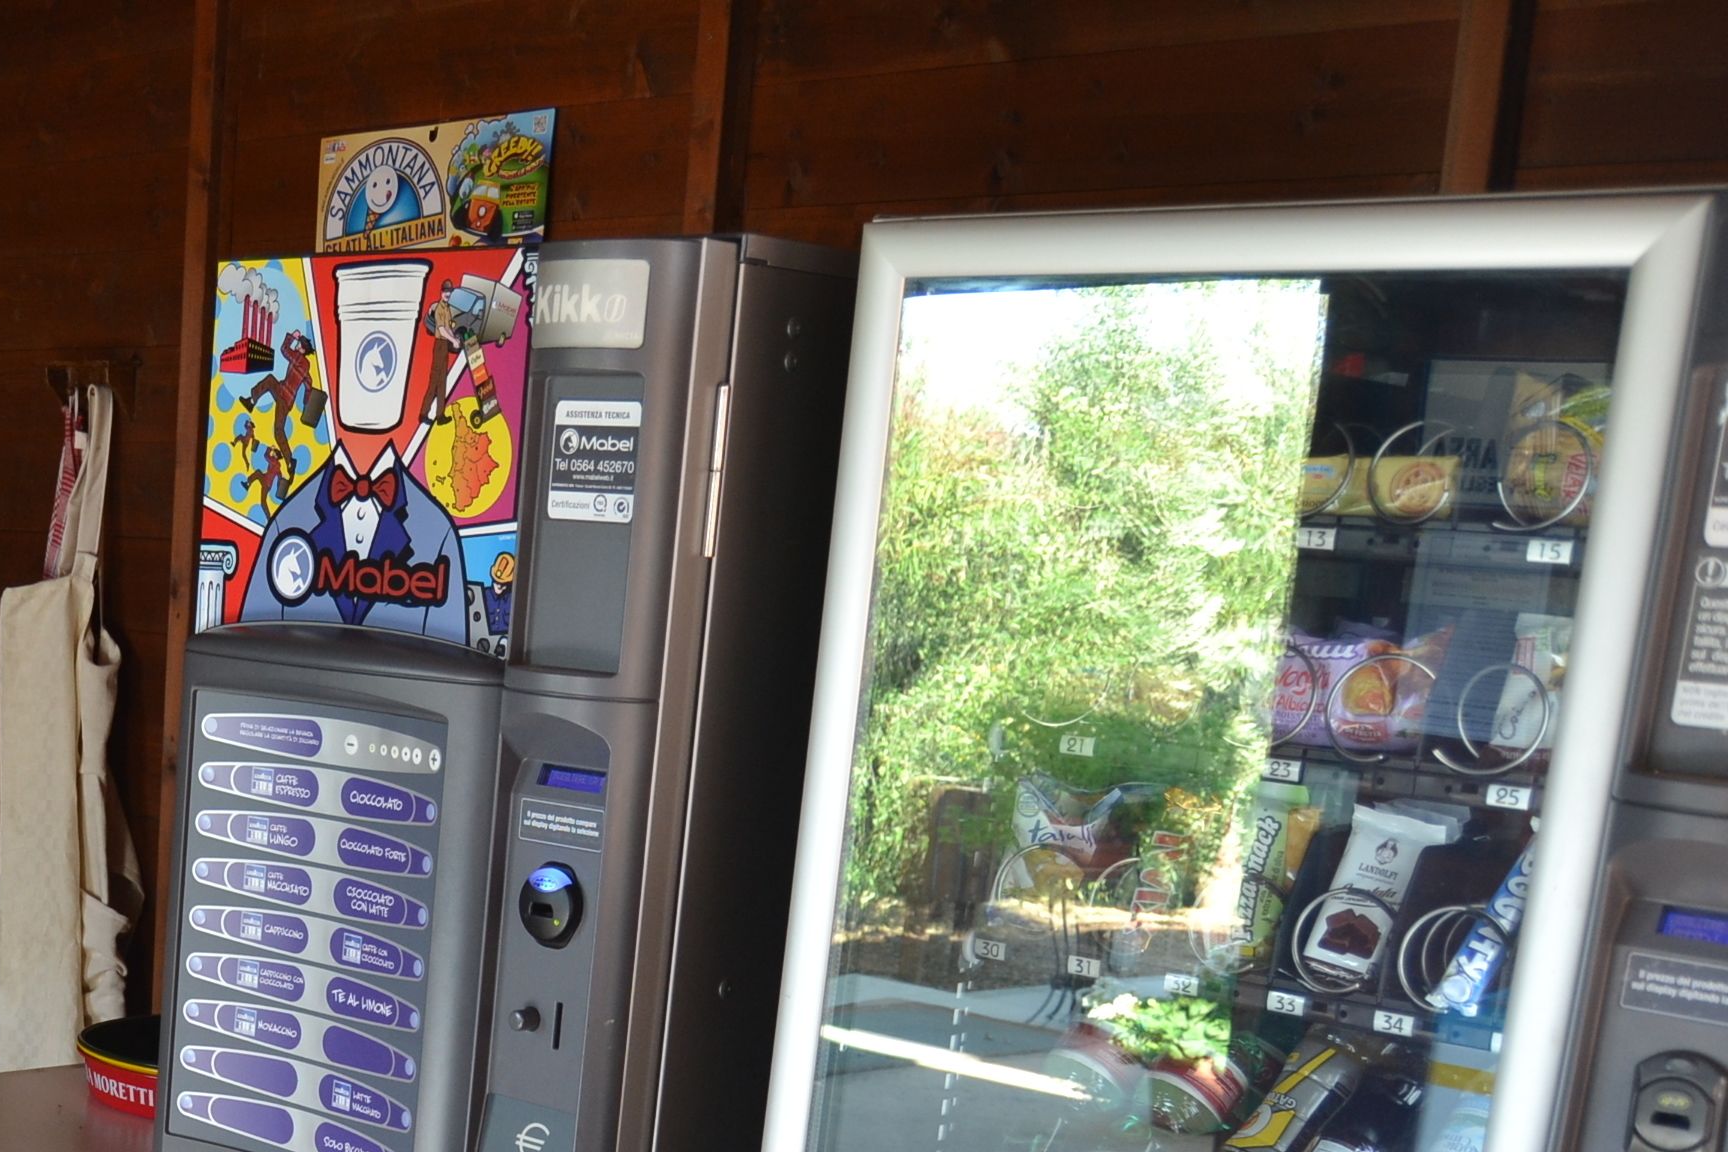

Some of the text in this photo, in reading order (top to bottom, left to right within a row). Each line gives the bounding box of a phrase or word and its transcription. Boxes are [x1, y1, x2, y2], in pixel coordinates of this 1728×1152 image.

[329, 144, 438, 221] SAMMONTANA
[365, 217, 444, 250] ALL'ITALIANA
[566, 410, 630, 419] ASSISTENZA TECNICA
[580, 435, 634, 451] Mabel
[555, 458, 635, 473] Tel 0564 452670
[552, 500, 589, 510] Certificazioni
[1306, 530, 1327, 547] 13
[1538, 543, 1561, 560] 15
[317, 556, 446, 600] Mabel
[1067, 738, 1085, 753] 21
[1270, 760, 1291, 778] 23
[275, 785, 310, 798] ESPRESSO
[1495, 788, 1520, 806] 25
[350, 790, 403, 811] CIOCCOLATO
[269, 834, 298, 847] LUNGO
[340, 839, 407, 862] CIOCCOLATO FORTE
[267, 880, 309, 897] MACCHIATO
[346, 886, 394, 907] CIOCCOLATO
[351, 899, 390, 918] CON LATTE
[264, 924, 303, 940] CAPPUCCINO
[981, 942, 999, 958] 30
[260, 968, 292, 981] CAPPUCCINO
[1074, 959, 1092, 975] 31
[259, 977, 294, 990] CIOCCOLATO
[347, 992, 359, 1007] AL
[361, 996, 392, 1017] LIMONE
[1274, 996, 1296, 1013] 33
[1381, 1014, 1404, 1032] 34
[93, 1071, 155, 1108] MORETTI
[353, 1090, 372, 1104] LATTE
[323, 1136, 344, 1151] SOLO
